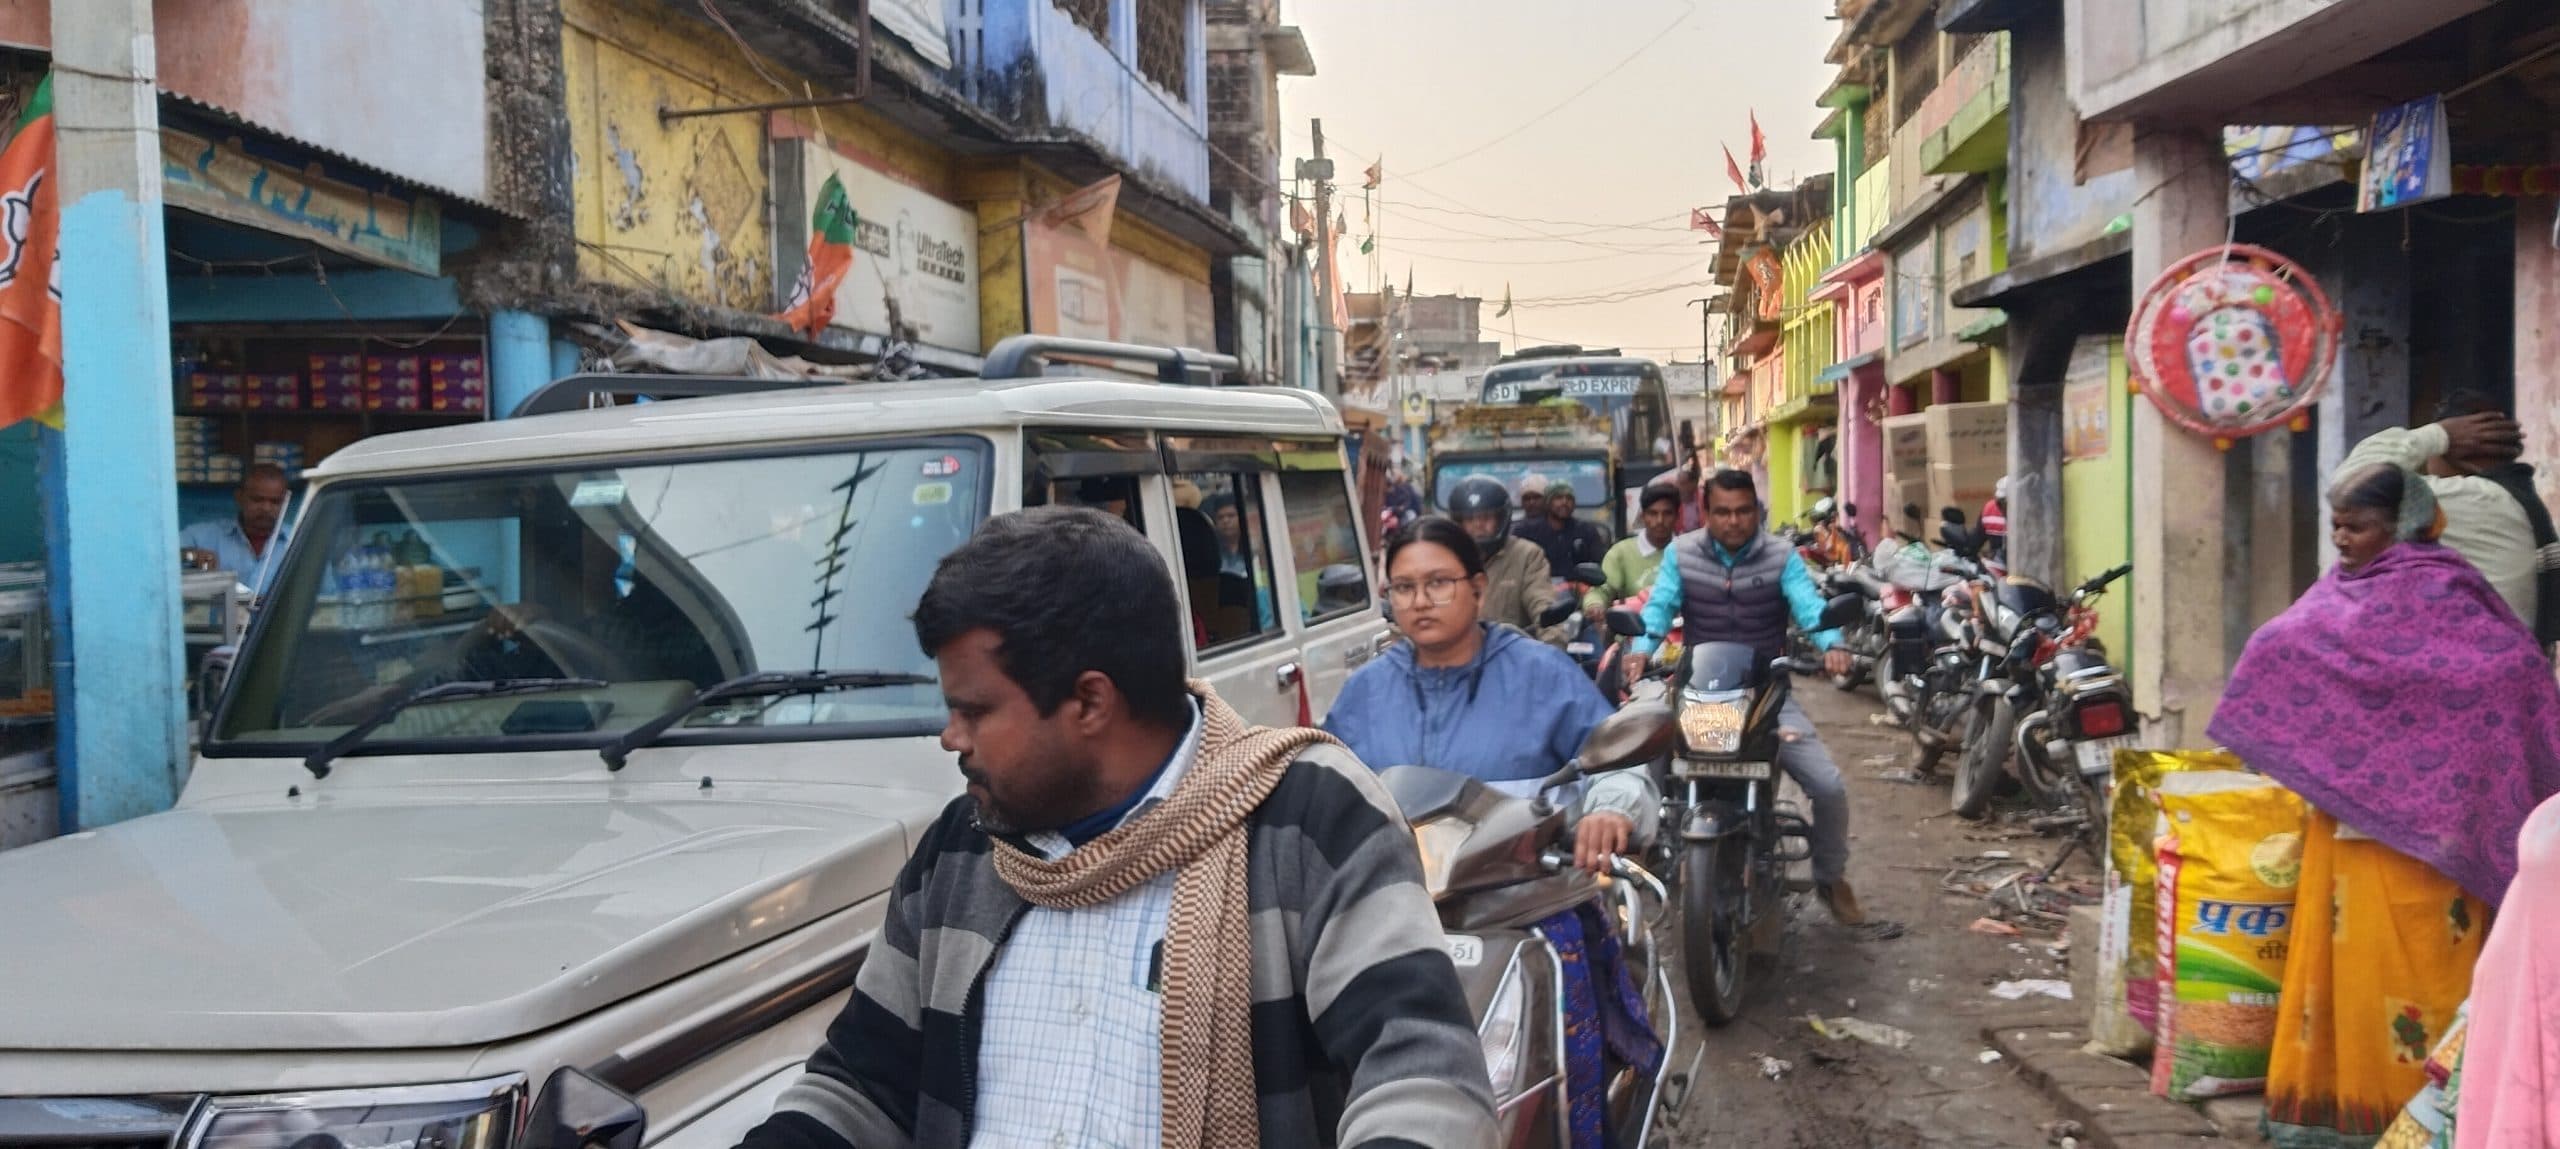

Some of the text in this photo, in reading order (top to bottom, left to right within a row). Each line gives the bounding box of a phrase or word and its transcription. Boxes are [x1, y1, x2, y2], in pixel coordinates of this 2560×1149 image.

[917, 231, 965, 268] UltraTech
[2191, 899, 2294, 935] प्रक
[1448, 943, 1473, 960] 51
